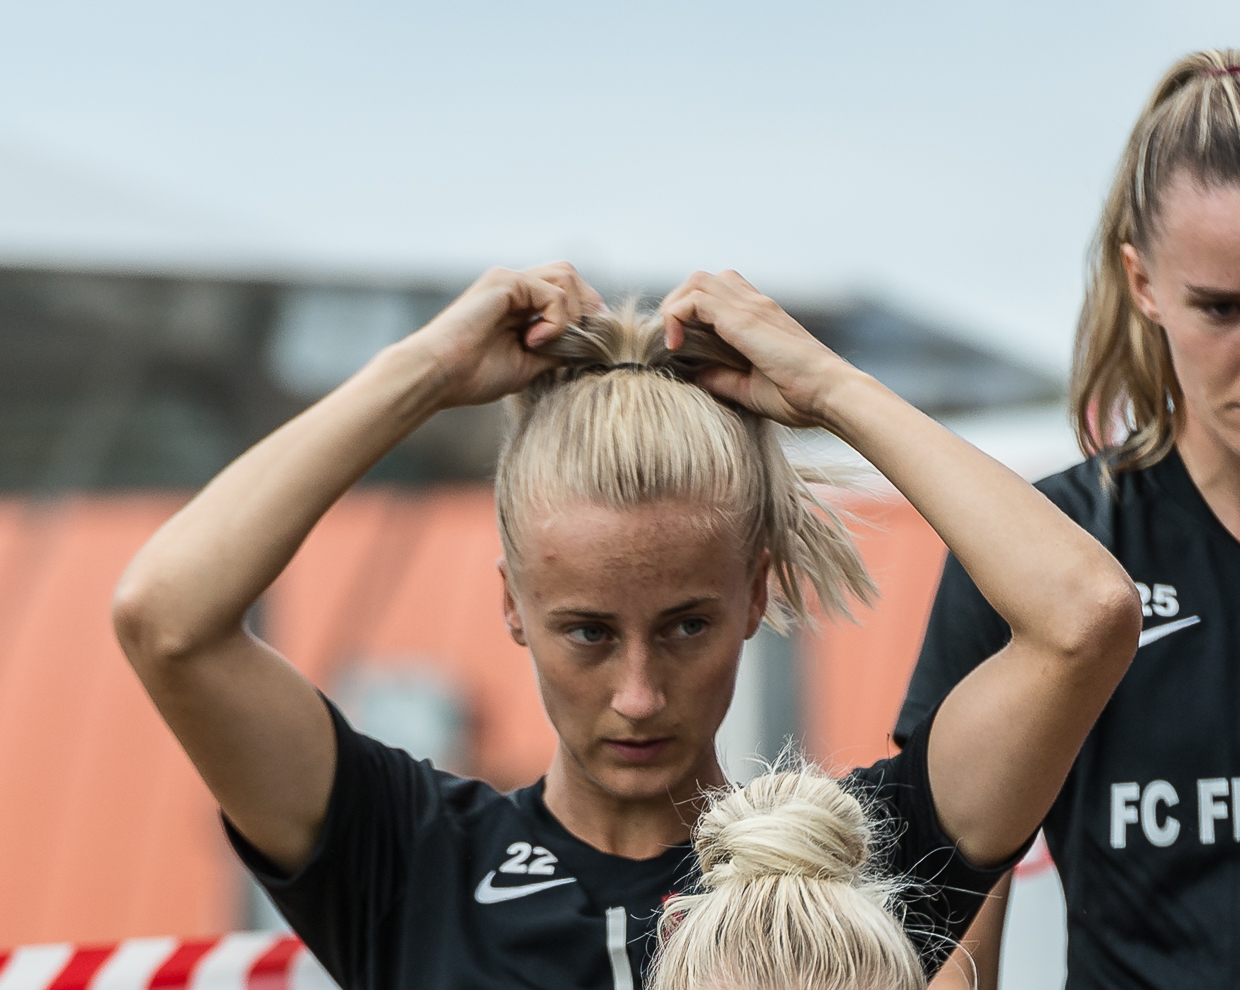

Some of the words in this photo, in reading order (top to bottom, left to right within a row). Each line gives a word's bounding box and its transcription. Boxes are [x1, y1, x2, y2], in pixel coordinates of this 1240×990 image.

[1134, 581, 1180, 617] 25
[1109, 778, 1181, 849] FC
[498, 841, 559, 876] 22
